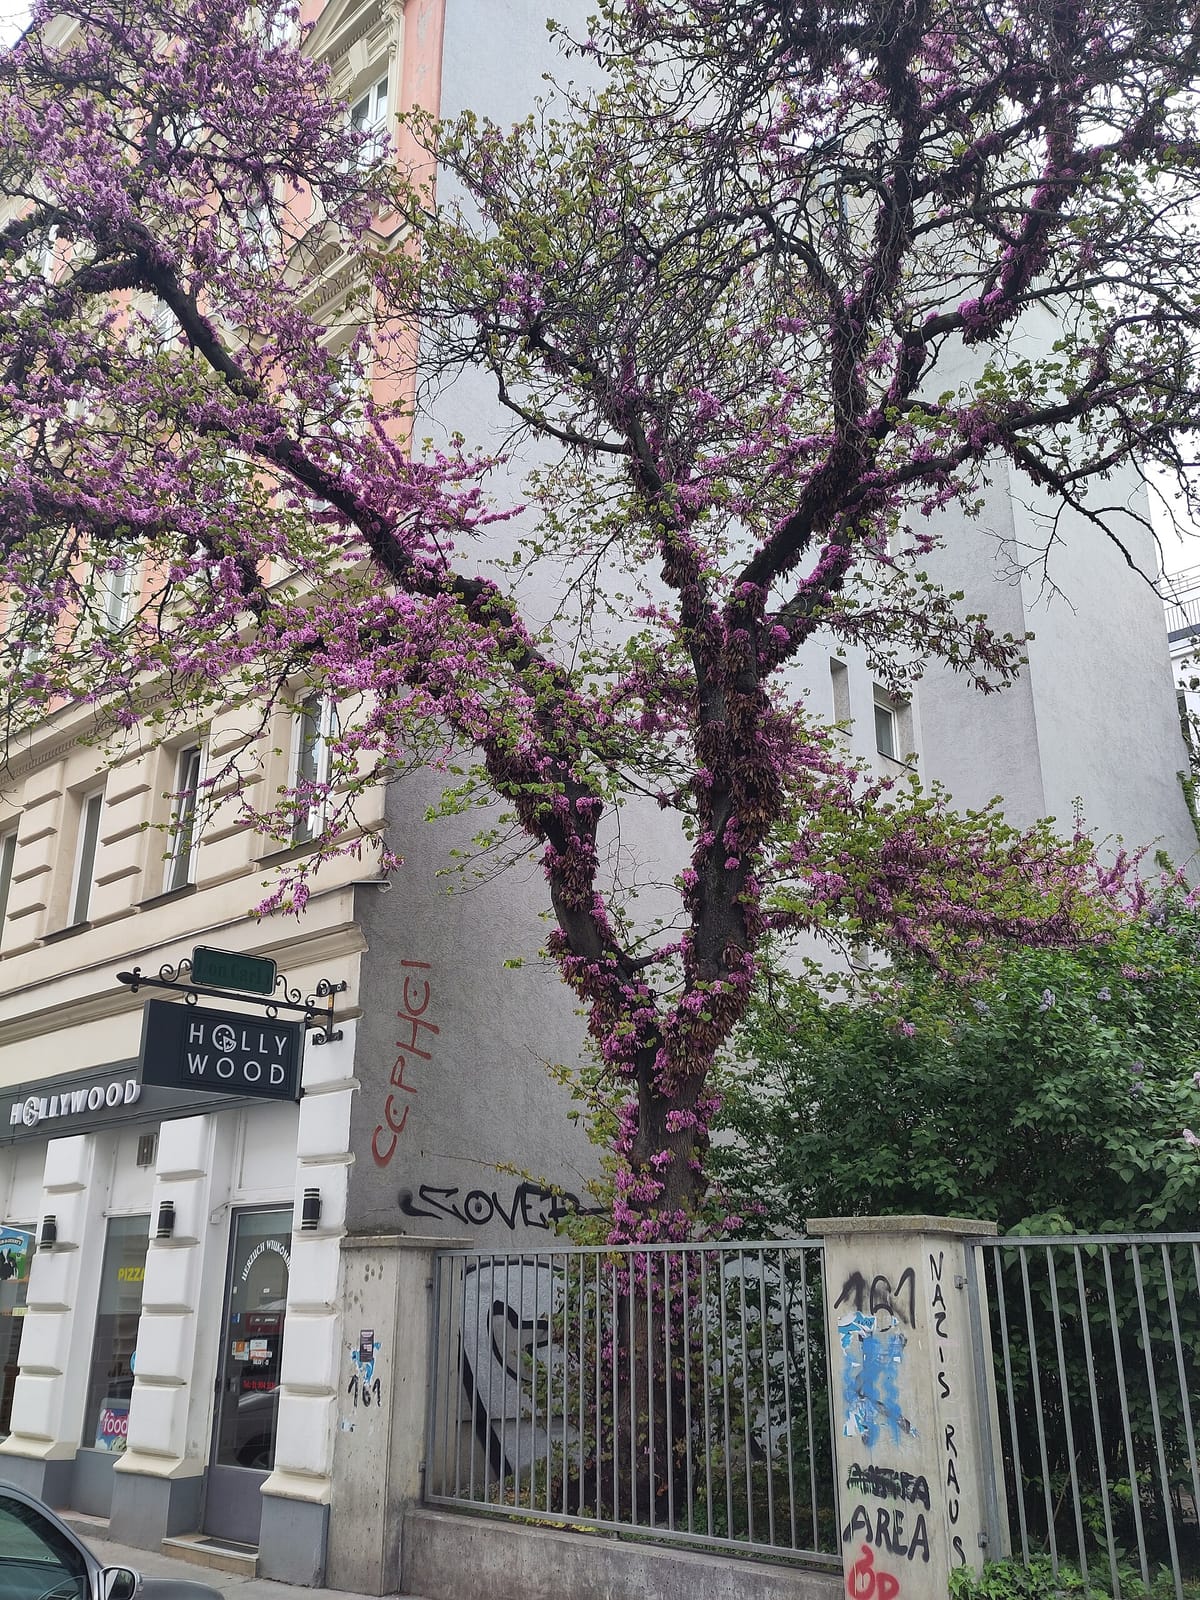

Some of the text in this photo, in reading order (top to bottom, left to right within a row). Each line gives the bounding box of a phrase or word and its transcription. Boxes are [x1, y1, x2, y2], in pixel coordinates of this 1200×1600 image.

[189, 1023, 288, 1056] HOLLY
[187, 1053, 285, 1084] WOOD
[10, 1079, 141, 1127] HOLLYWOOD
[929, 1251, 966, 1566] NAZIS RAUS
[842, 1504, 930, 1563] AREA
